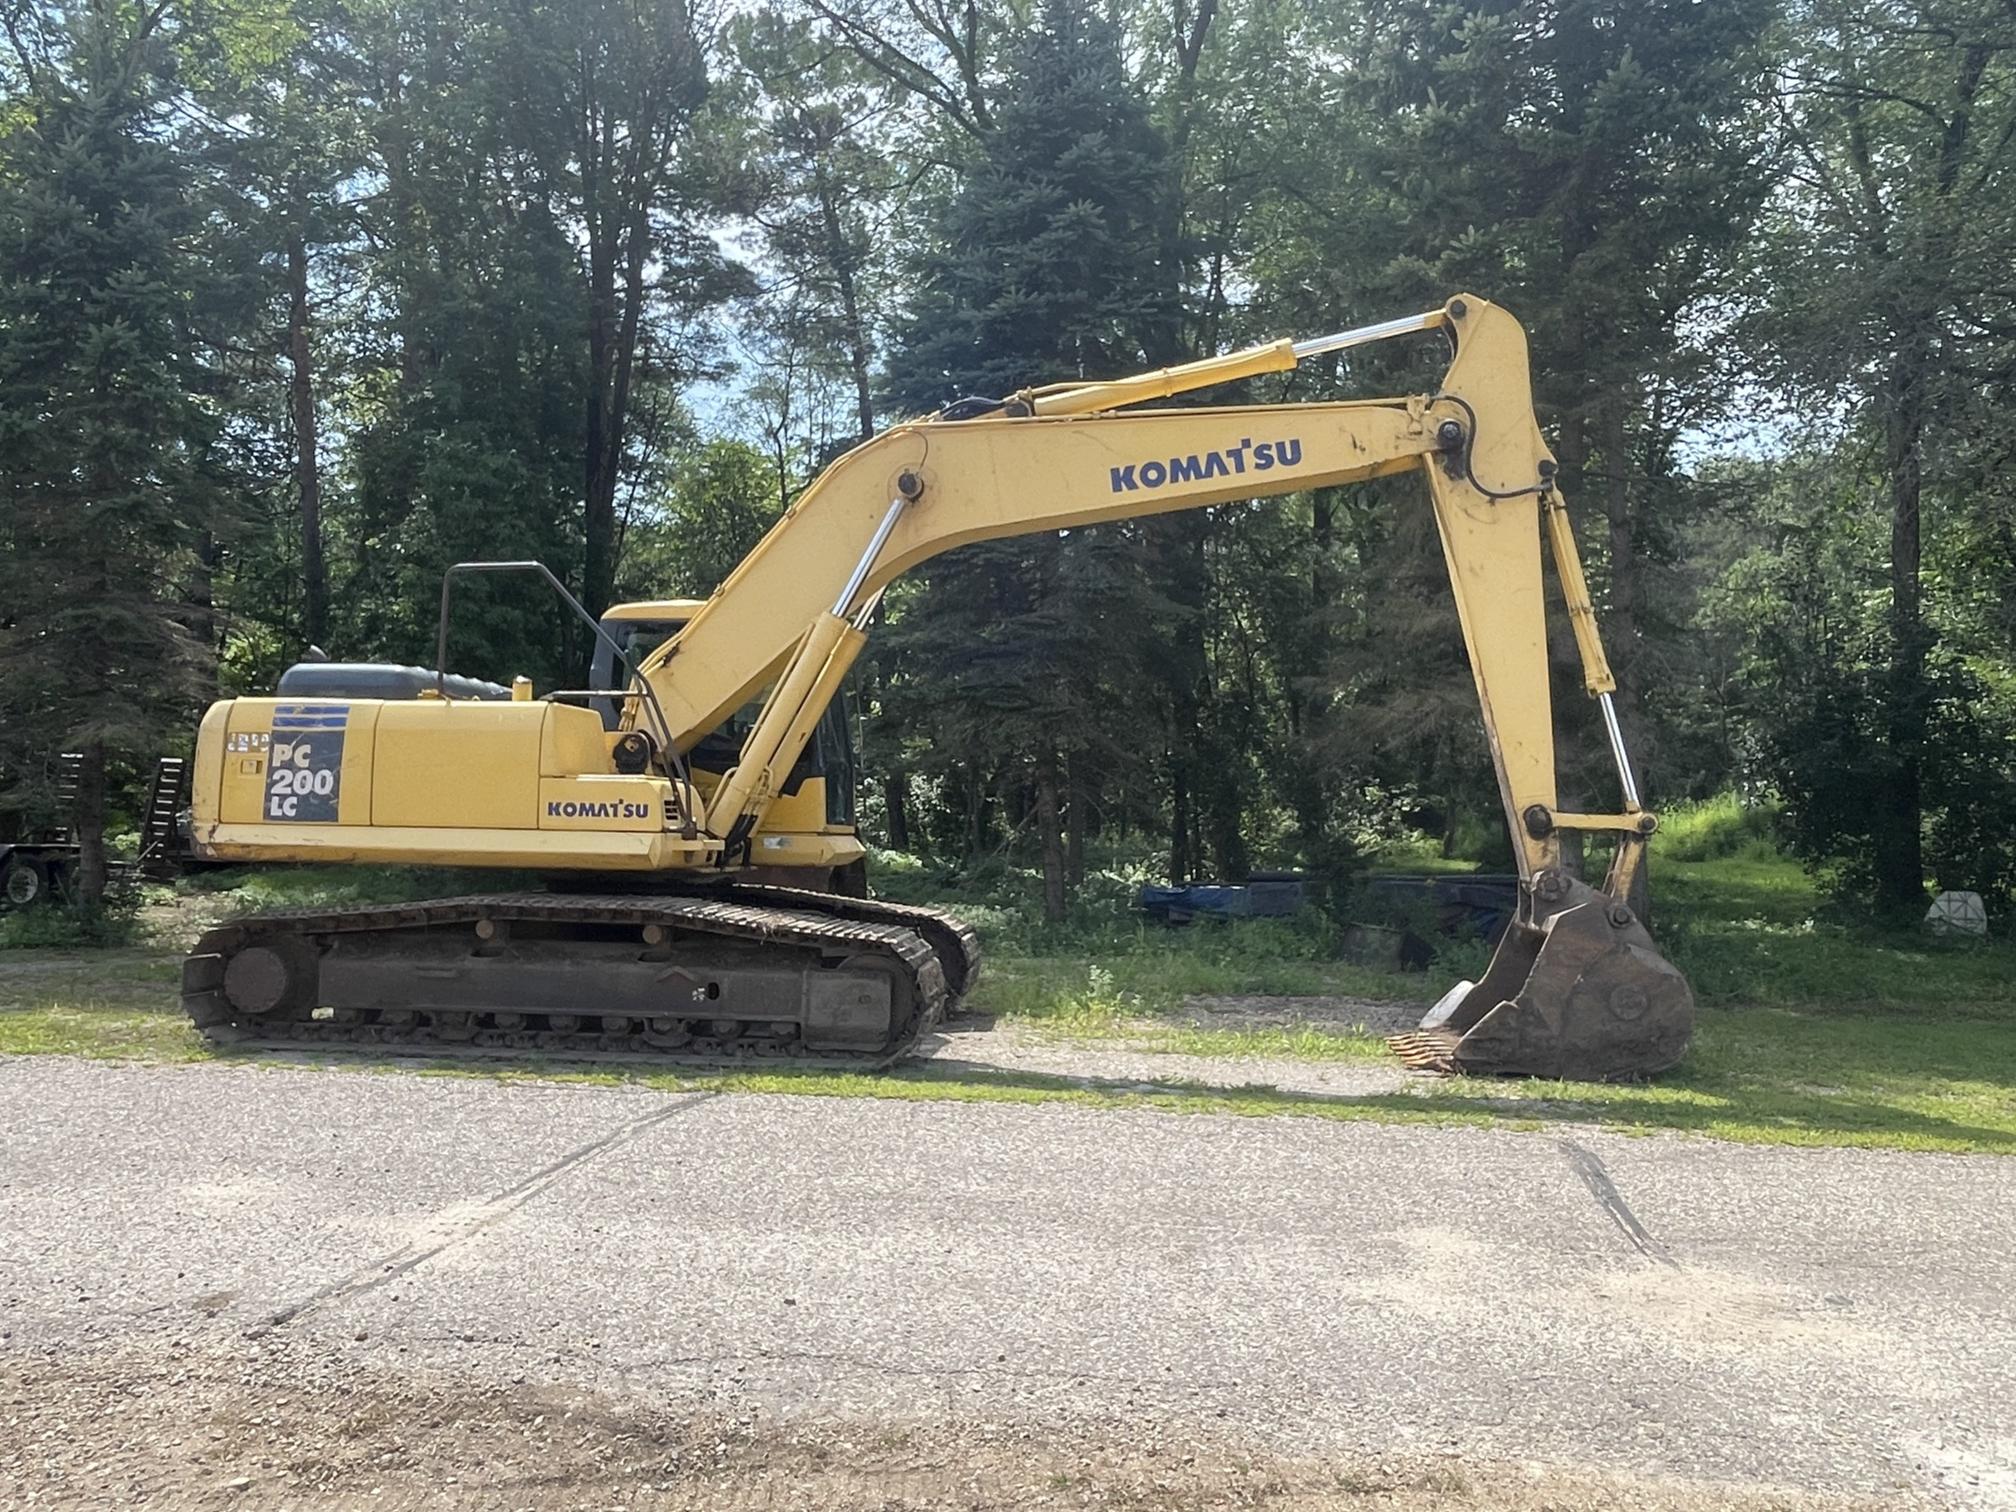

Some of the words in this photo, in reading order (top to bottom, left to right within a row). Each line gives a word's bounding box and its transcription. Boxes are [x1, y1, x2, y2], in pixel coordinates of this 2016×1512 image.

[1110, 438, 1302, 492] KOMATSU
[272, 744, 311, 767] PC
[270, 769, 334, 795] 200
[270, 796, 298, 817] LC
[548, 798, 649, 818] KOMATSU
